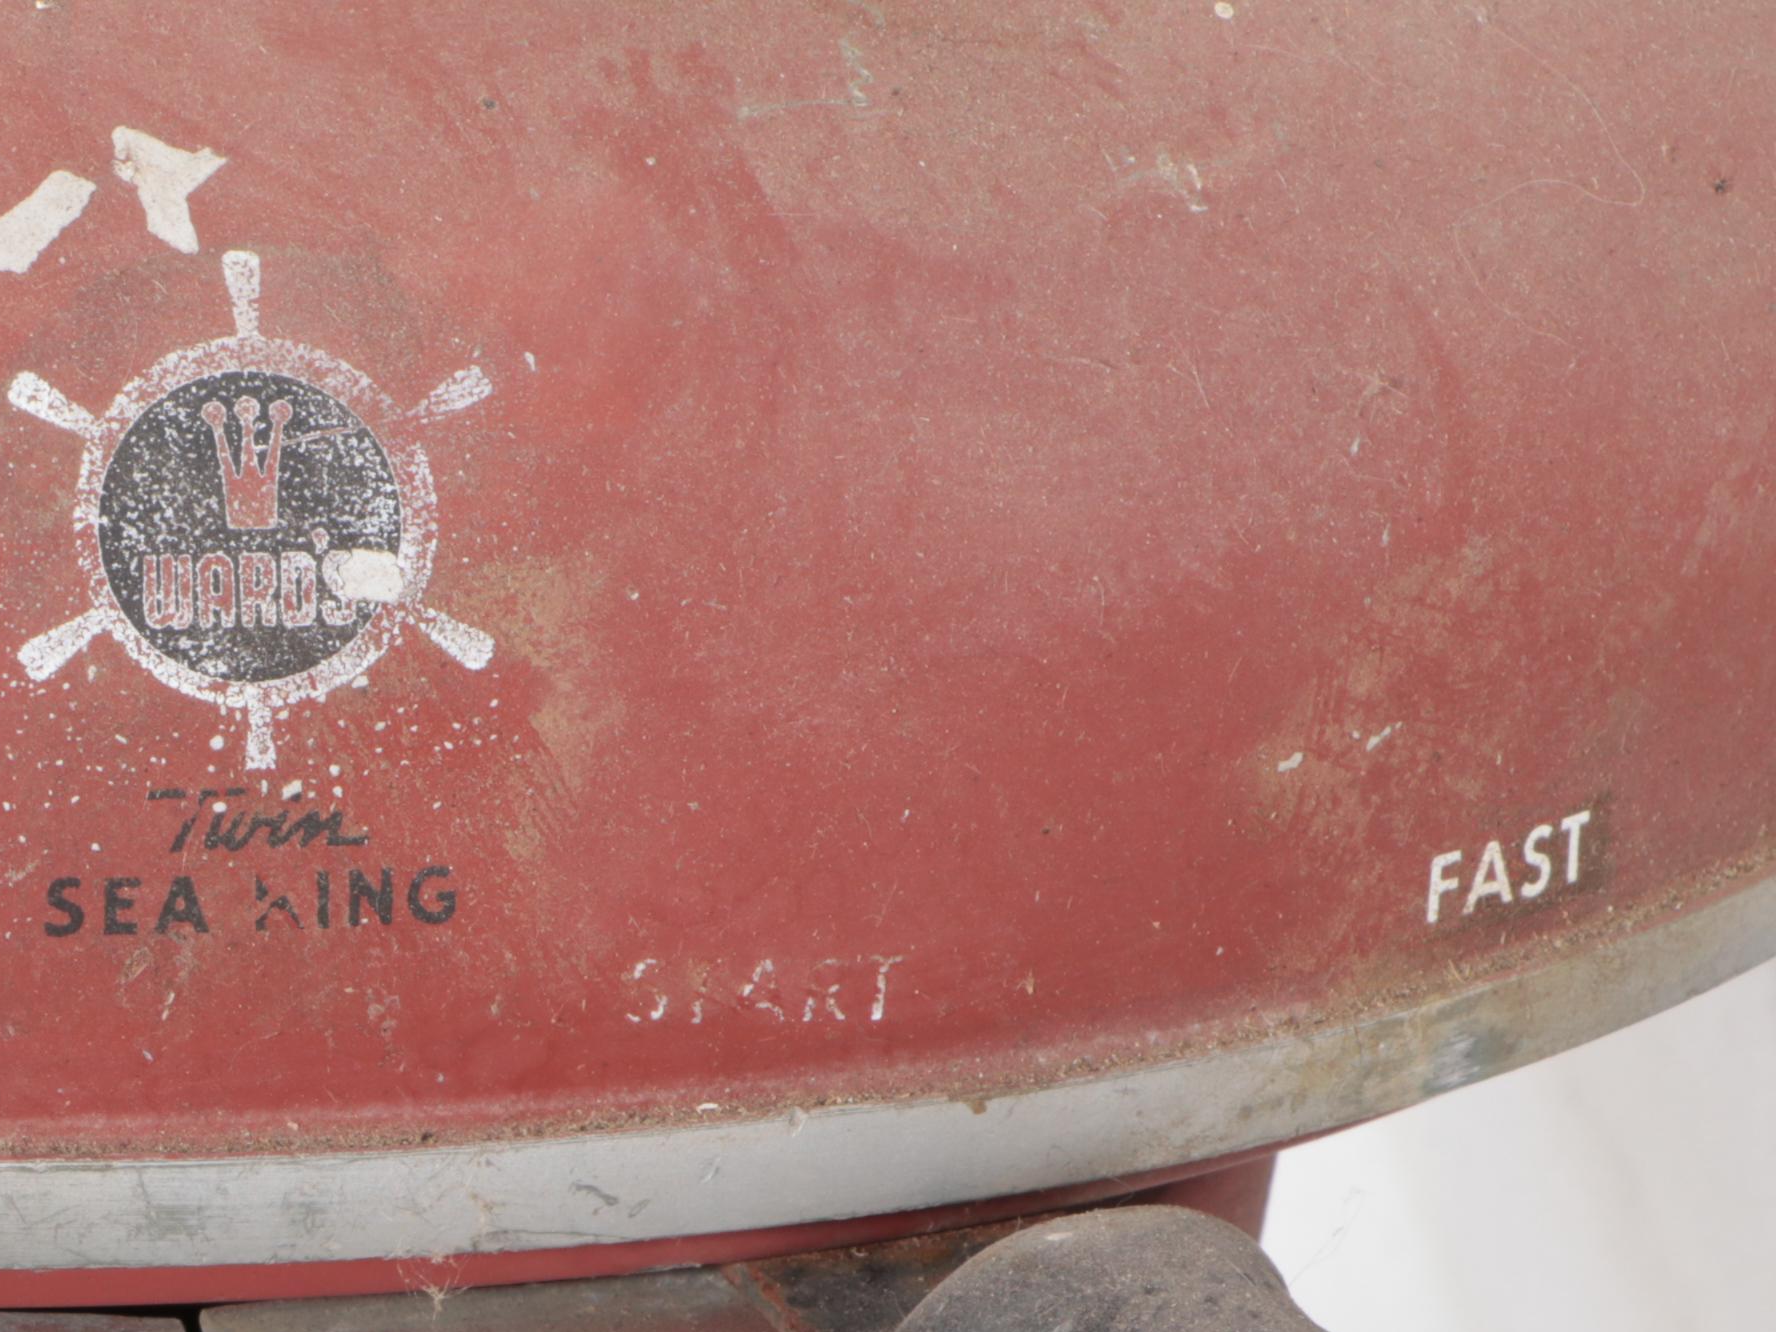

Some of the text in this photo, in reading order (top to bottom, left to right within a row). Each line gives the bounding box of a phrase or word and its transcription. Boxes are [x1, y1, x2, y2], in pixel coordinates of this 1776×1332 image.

[146, 786, 369, 853] Twin
[44, 865, 458, 937] SEA KING
[1426, 810, 1591, 923] FAST
